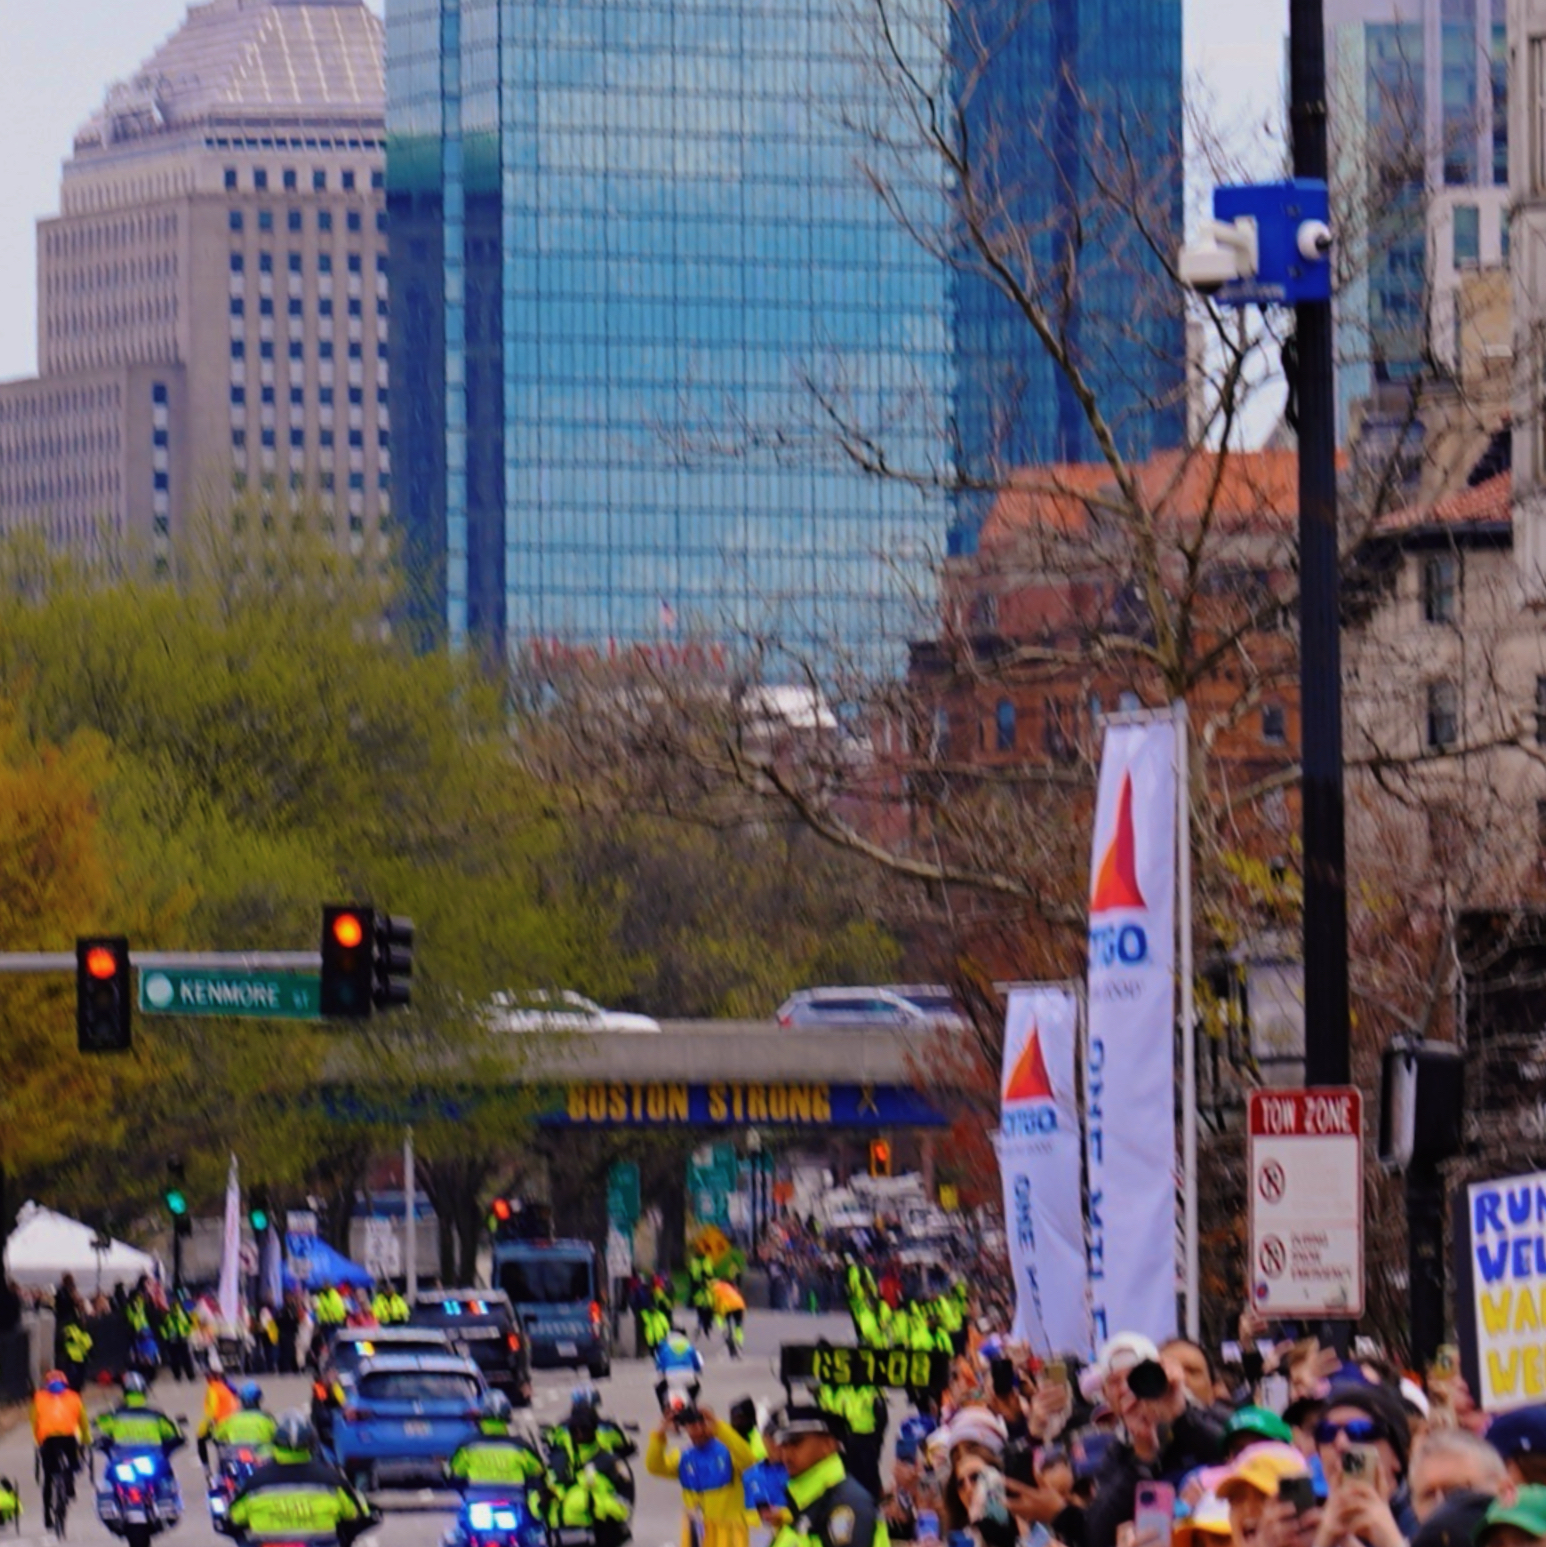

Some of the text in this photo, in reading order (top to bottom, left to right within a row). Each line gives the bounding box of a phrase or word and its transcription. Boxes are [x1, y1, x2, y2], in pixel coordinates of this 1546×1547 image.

[180, 976, 280, 1009] KENMORE
[567, 1080, 832, 1123] BOSTON STRONG
[1261, 1095, 1352, 1134] TOW ZONE
